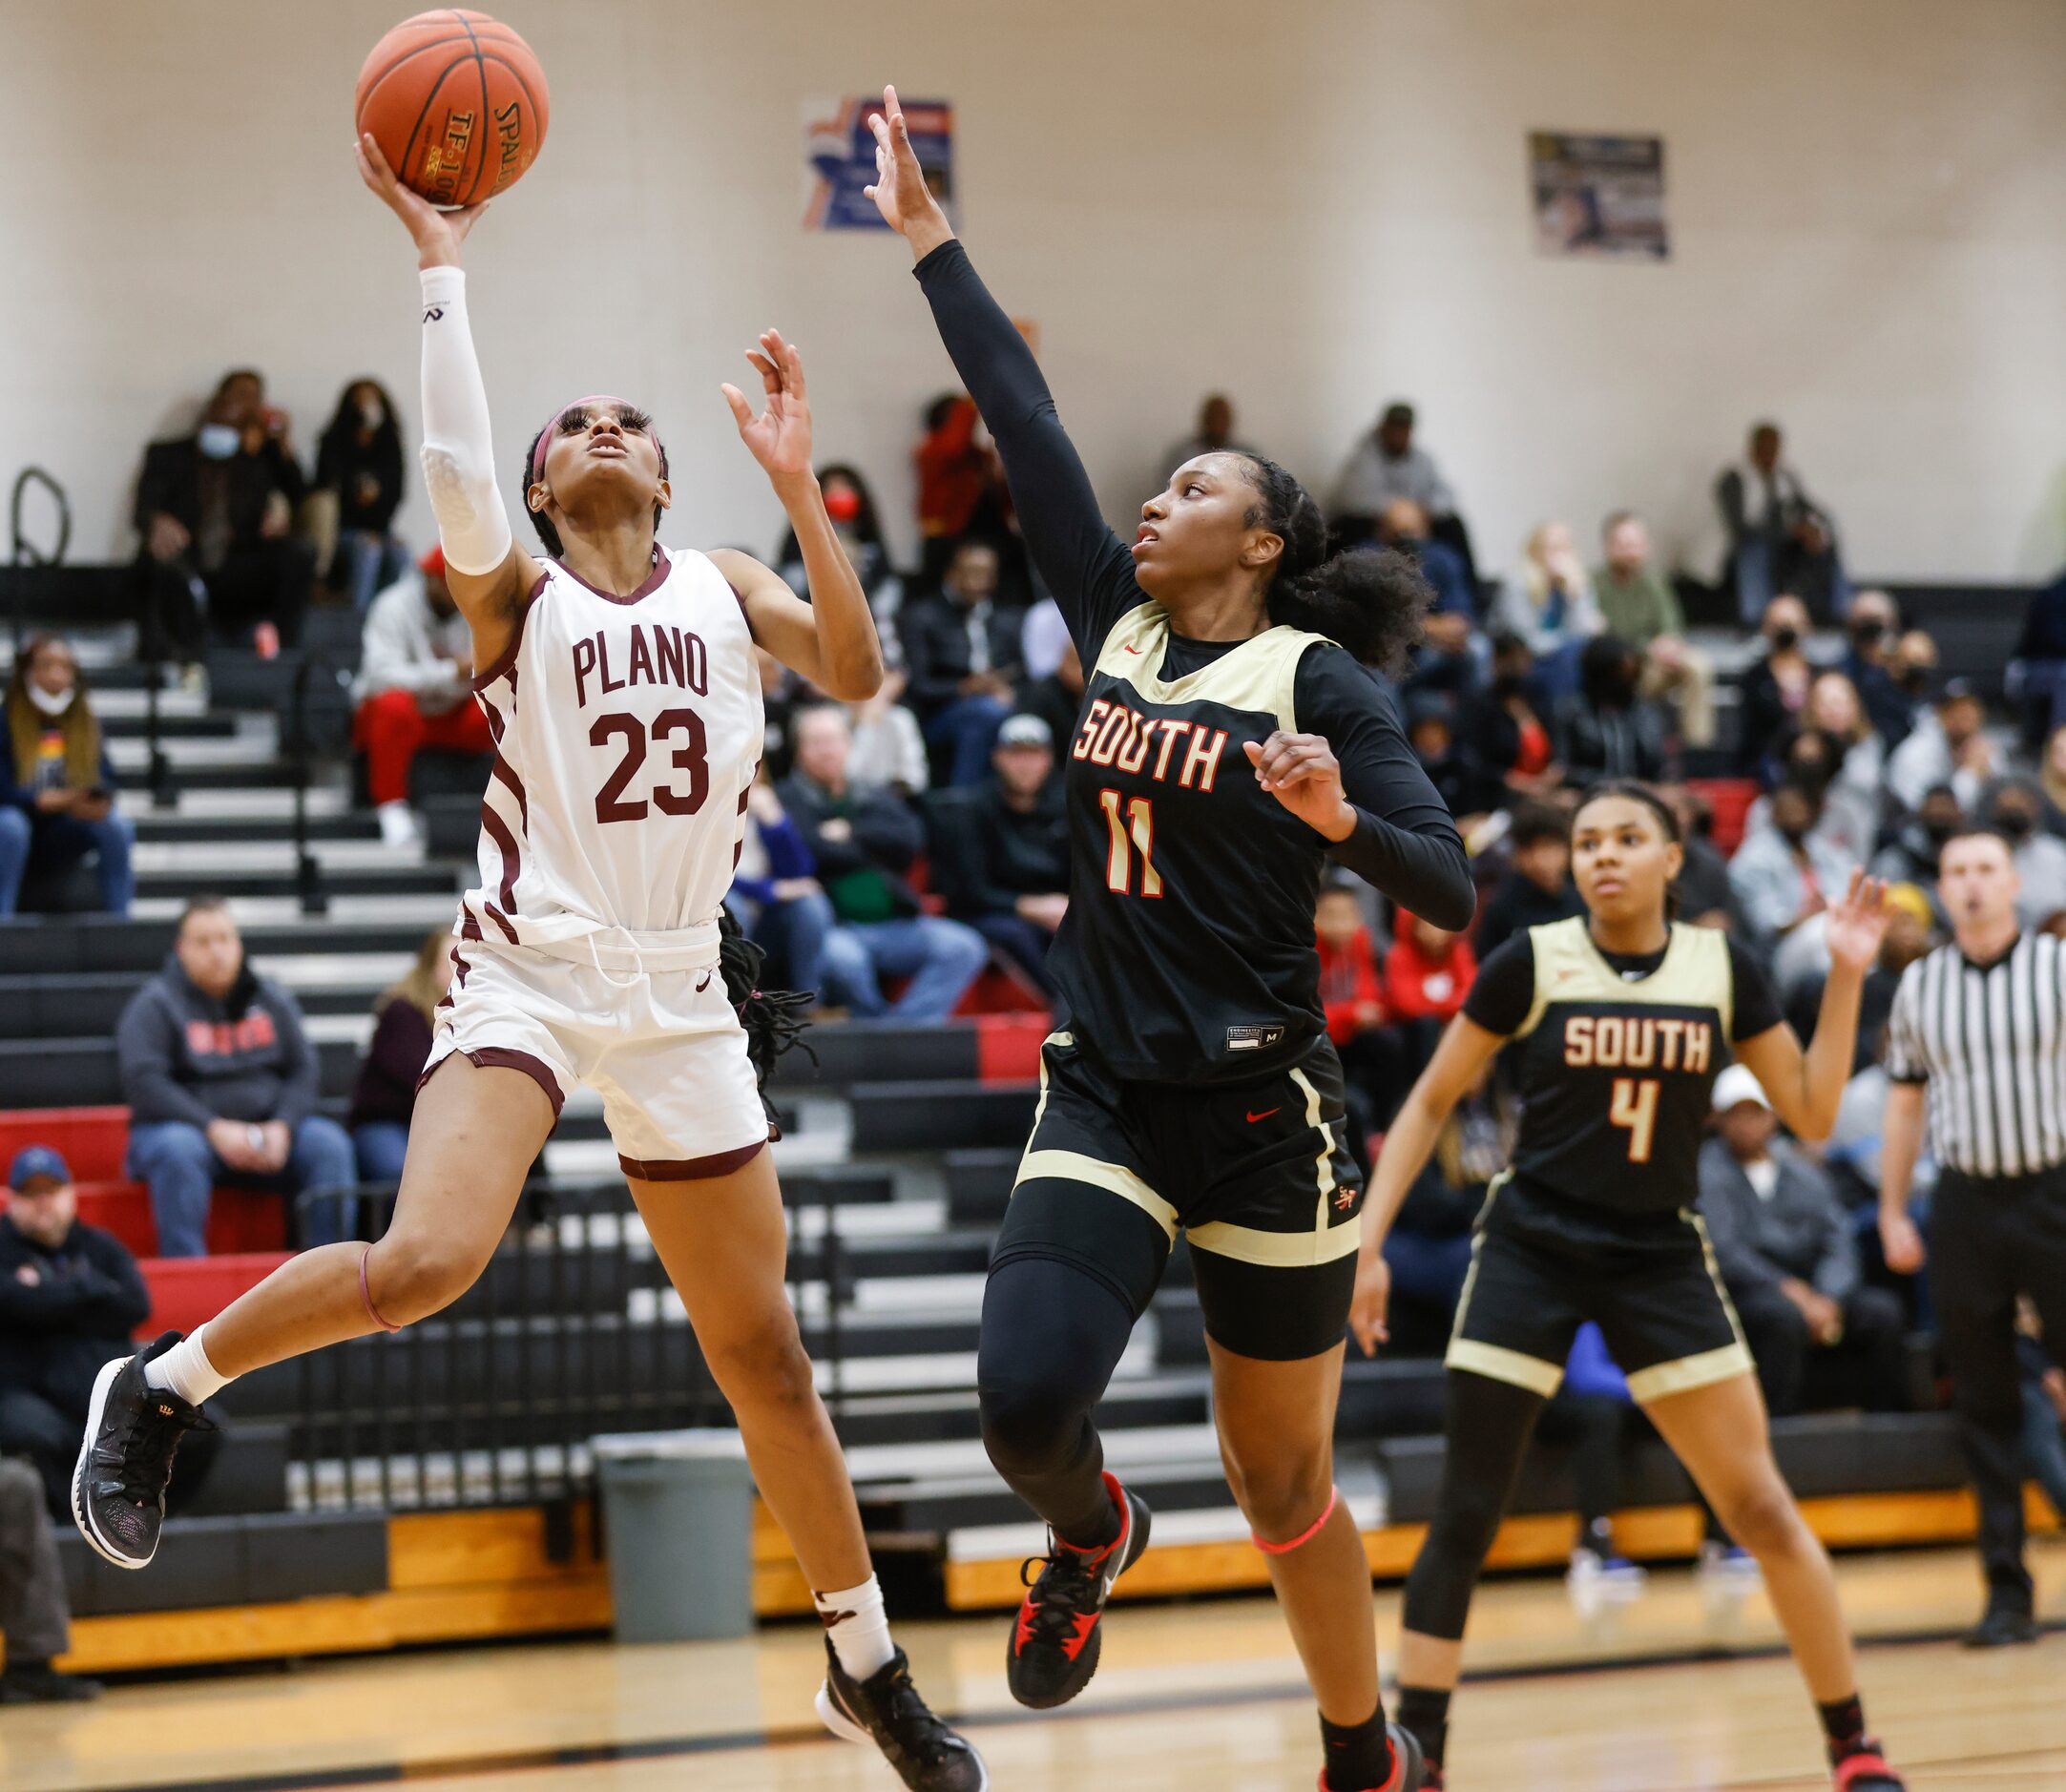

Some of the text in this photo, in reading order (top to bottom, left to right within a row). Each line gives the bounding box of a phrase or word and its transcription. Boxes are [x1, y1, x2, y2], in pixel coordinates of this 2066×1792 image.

[573, 624, 709, 709] PLANO
[589, 708, 710, 824] 23
[1073, 698, 1229, 793] SOUTH
[1099, 787, 1163, 899] 11
[1266, 1033, 1277, 1042] M
[1564, 1015, 1711, 1073] SOUTH
[1609, 1076, 1661, 1165] 4
